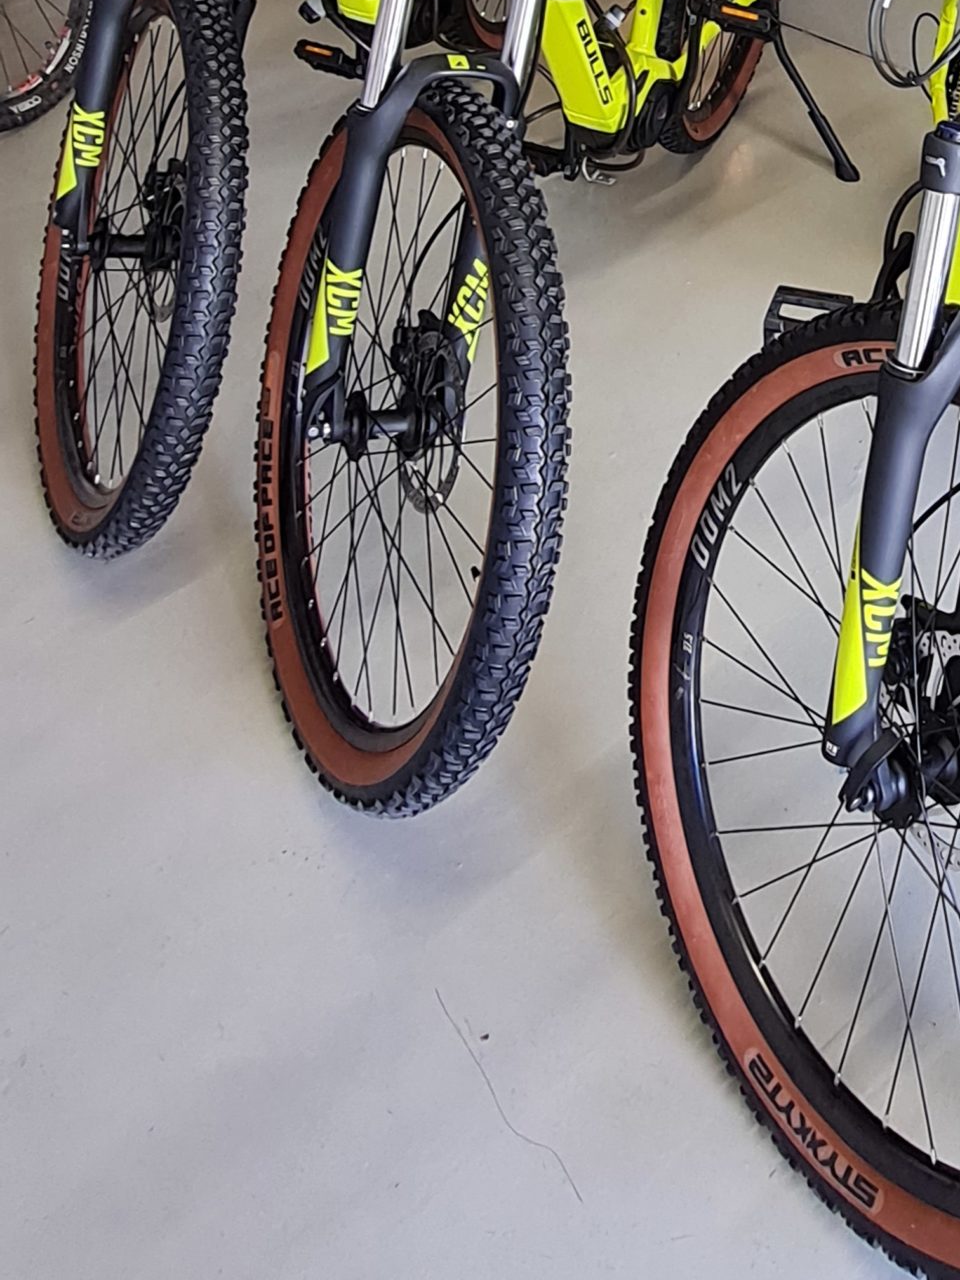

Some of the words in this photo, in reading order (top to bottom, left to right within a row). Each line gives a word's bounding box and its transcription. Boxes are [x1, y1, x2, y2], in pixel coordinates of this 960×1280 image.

[576, 19, 613, 105] BULLS
[73, 102, 105, 168] XCM
[326, 258, 362, 336] XCM
